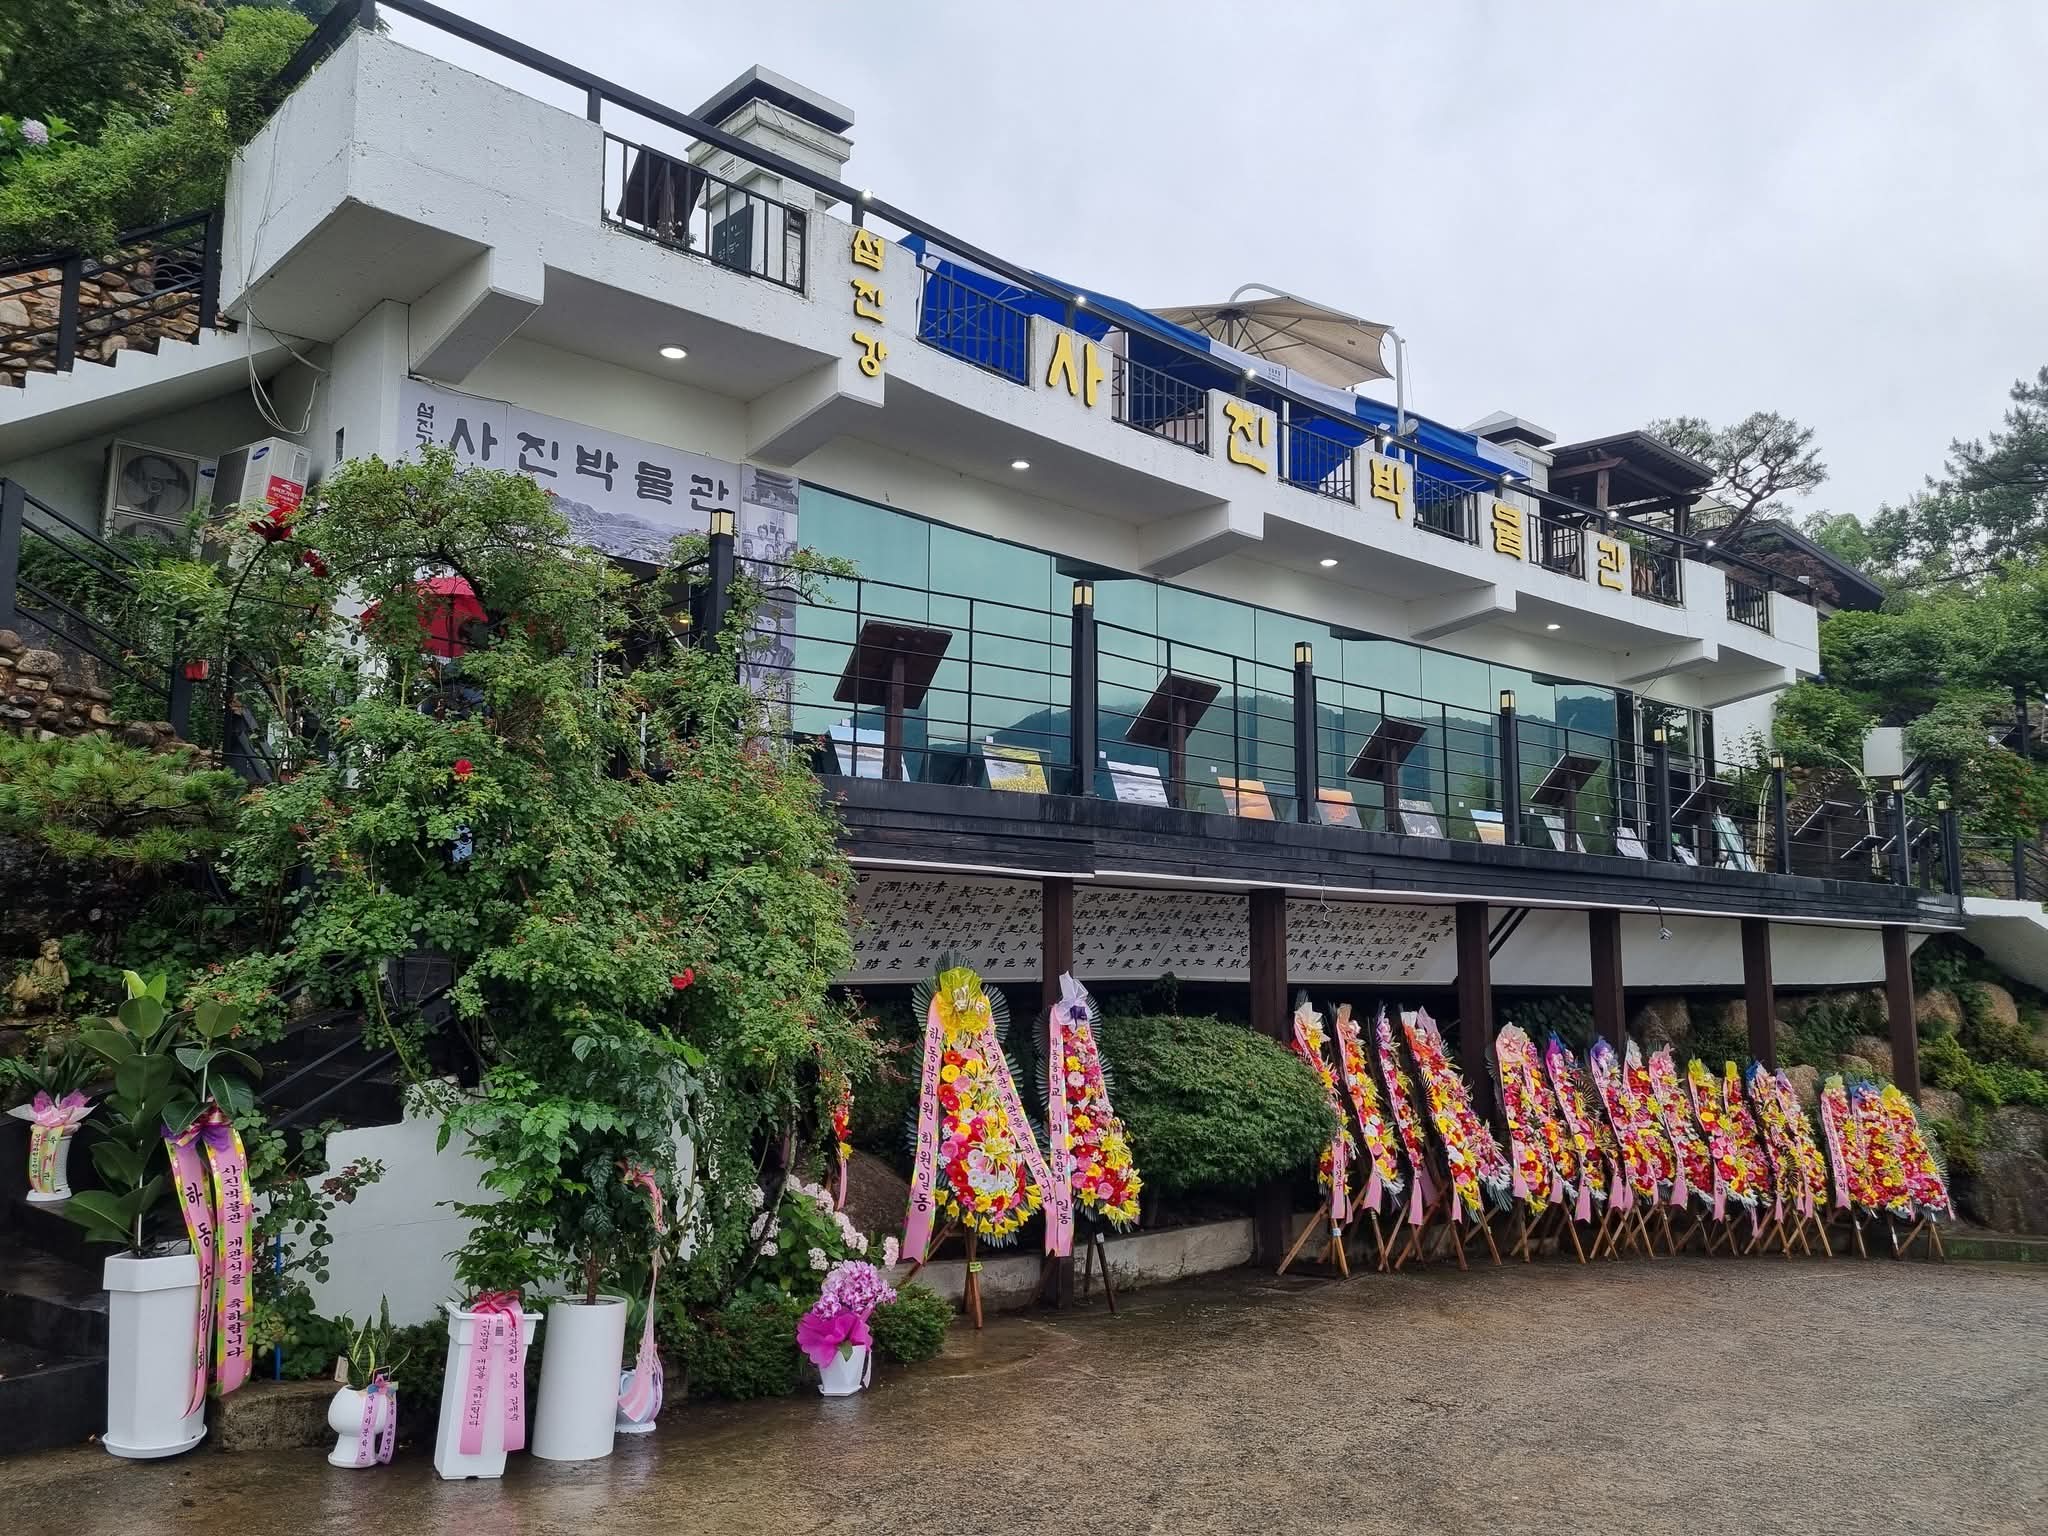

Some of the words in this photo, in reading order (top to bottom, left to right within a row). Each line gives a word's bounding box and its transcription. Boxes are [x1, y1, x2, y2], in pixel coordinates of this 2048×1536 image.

[851, 229, 889, 378] 섬진강
[449, 417, 730, 512] 사진박물관
[1050, 1037, 1062, 1096] 하동중학교
[222, 1164, 245, 1224] 사진박물관
[1020, 1132, 1054, 1205] 축하드립니다
[1055, 1199, 1072, 1225] 일동
[226, 1236, 247, 1286] 개관식을
[226, 1298, 246, 1358] 축하합니다
